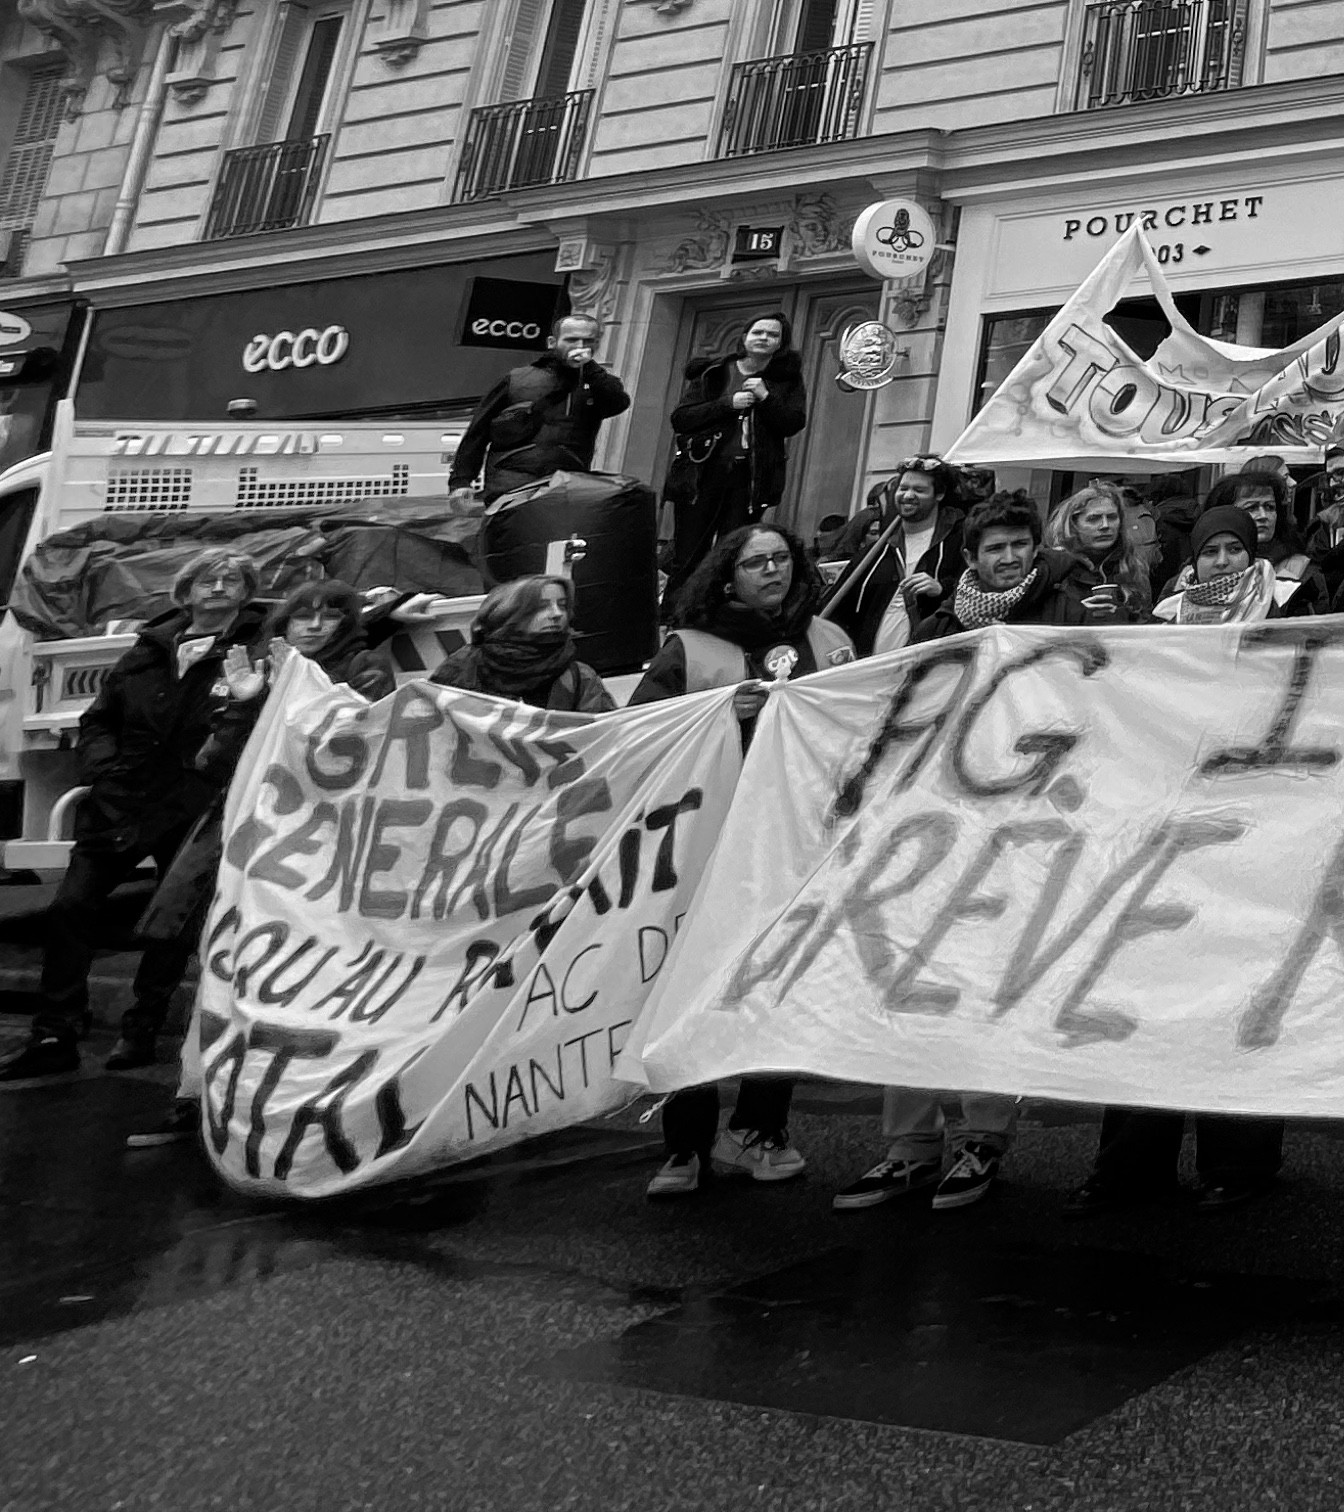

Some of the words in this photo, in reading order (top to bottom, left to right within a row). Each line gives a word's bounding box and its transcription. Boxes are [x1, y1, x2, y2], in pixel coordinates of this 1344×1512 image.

[1063, 196, 1264, 240] POURCHET
[750, 232, 774, 250] 15
[243, 324, 349, 372] ecco
[471, 318, 541, 339] ecco
[518, 943, 603, 1032] AC
[639, 912, 688, 984] D
